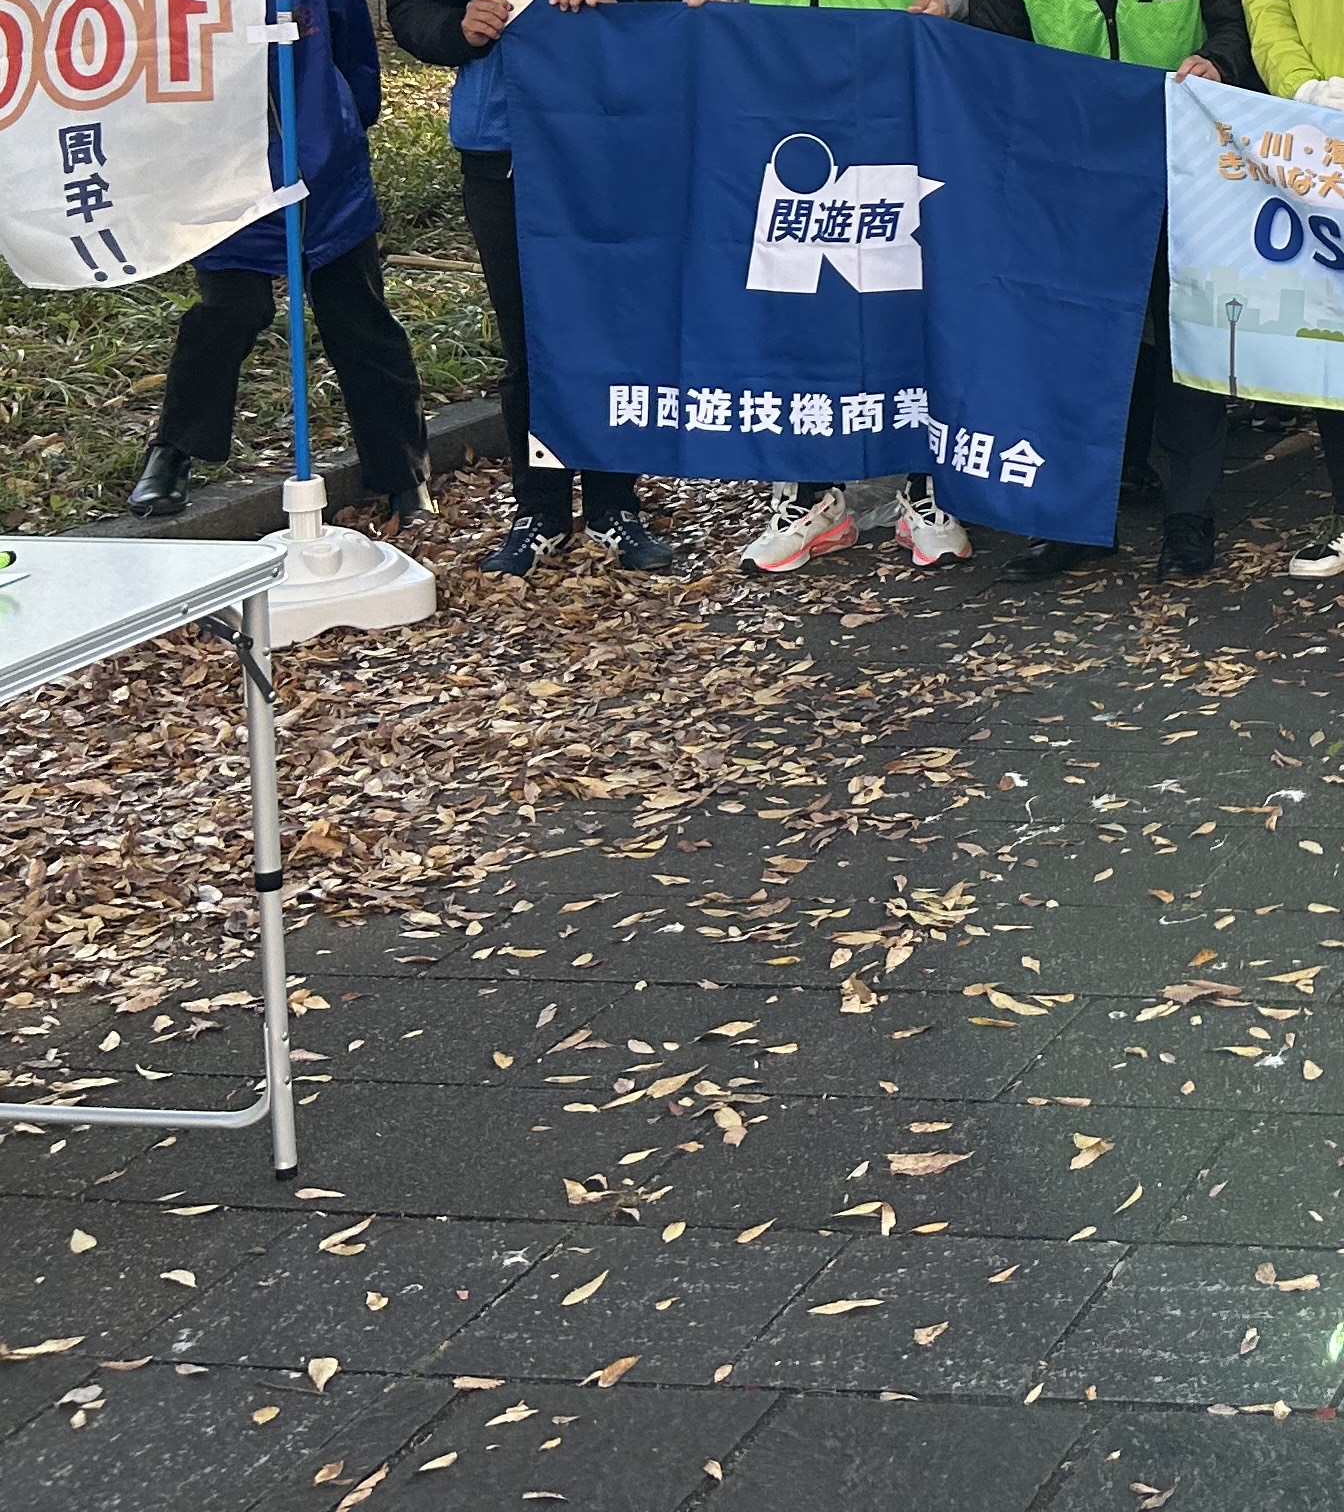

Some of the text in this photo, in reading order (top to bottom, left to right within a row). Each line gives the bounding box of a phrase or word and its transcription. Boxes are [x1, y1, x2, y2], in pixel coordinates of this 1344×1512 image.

[766, 197, 904, 244] 関遊商
[608, 384, 1045, 488] 関西遊技機商業同組合
